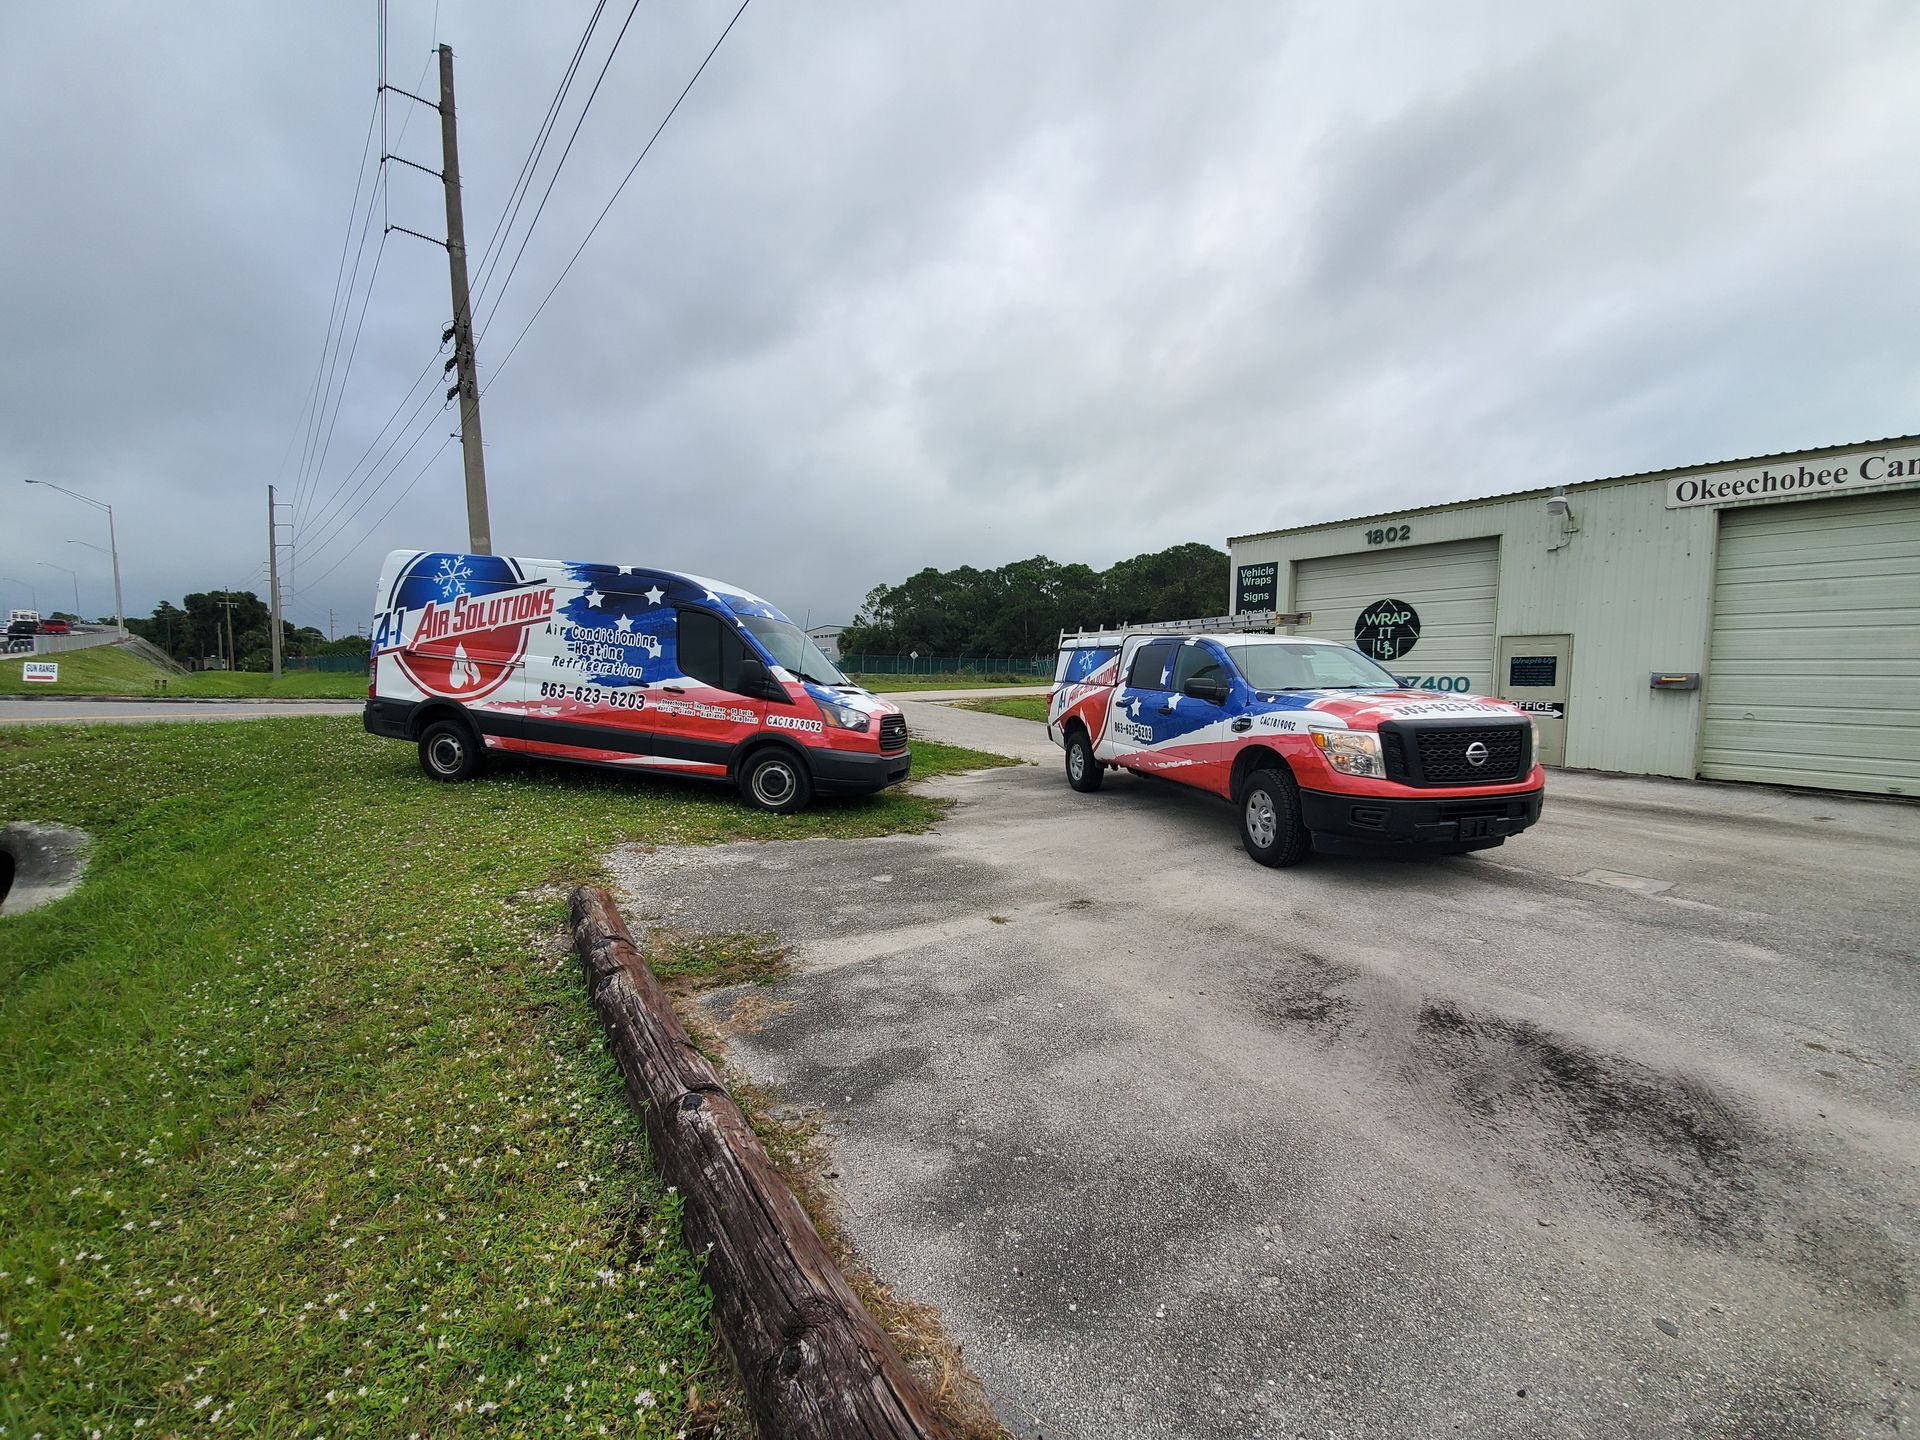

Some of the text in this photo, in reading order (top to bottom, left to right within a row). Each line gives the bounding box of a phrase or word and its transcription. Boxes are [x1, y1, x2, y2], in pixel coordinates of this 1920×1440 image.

[1676, 466, 1848, 502] Okeechobee
[1365, 525, 1410, 544] 1802
[1241, 566, 1274, 577] Vehicle
[1242, 576, 1272, 587] Wraps
[1243, 592, 1269, 602] Signs
[1365, 611, 1411, 626] WRAP
[545, 623, 657, 648] Air Conditioning
[1377, 626, 1395, 639] IT
[575, 641, 624, 660] Heating
[26, 664, 55, 672] GUN RANGE
[552, 656, 642, 678] Refrigeration
[540, 681, 646, 710] 863-623-6203
[767, 716, 822, 731] CAC1819092
[1114, 721, 1152, 740] 863-623-6203
[1260, 716, 1296, 731] CAC1819092
